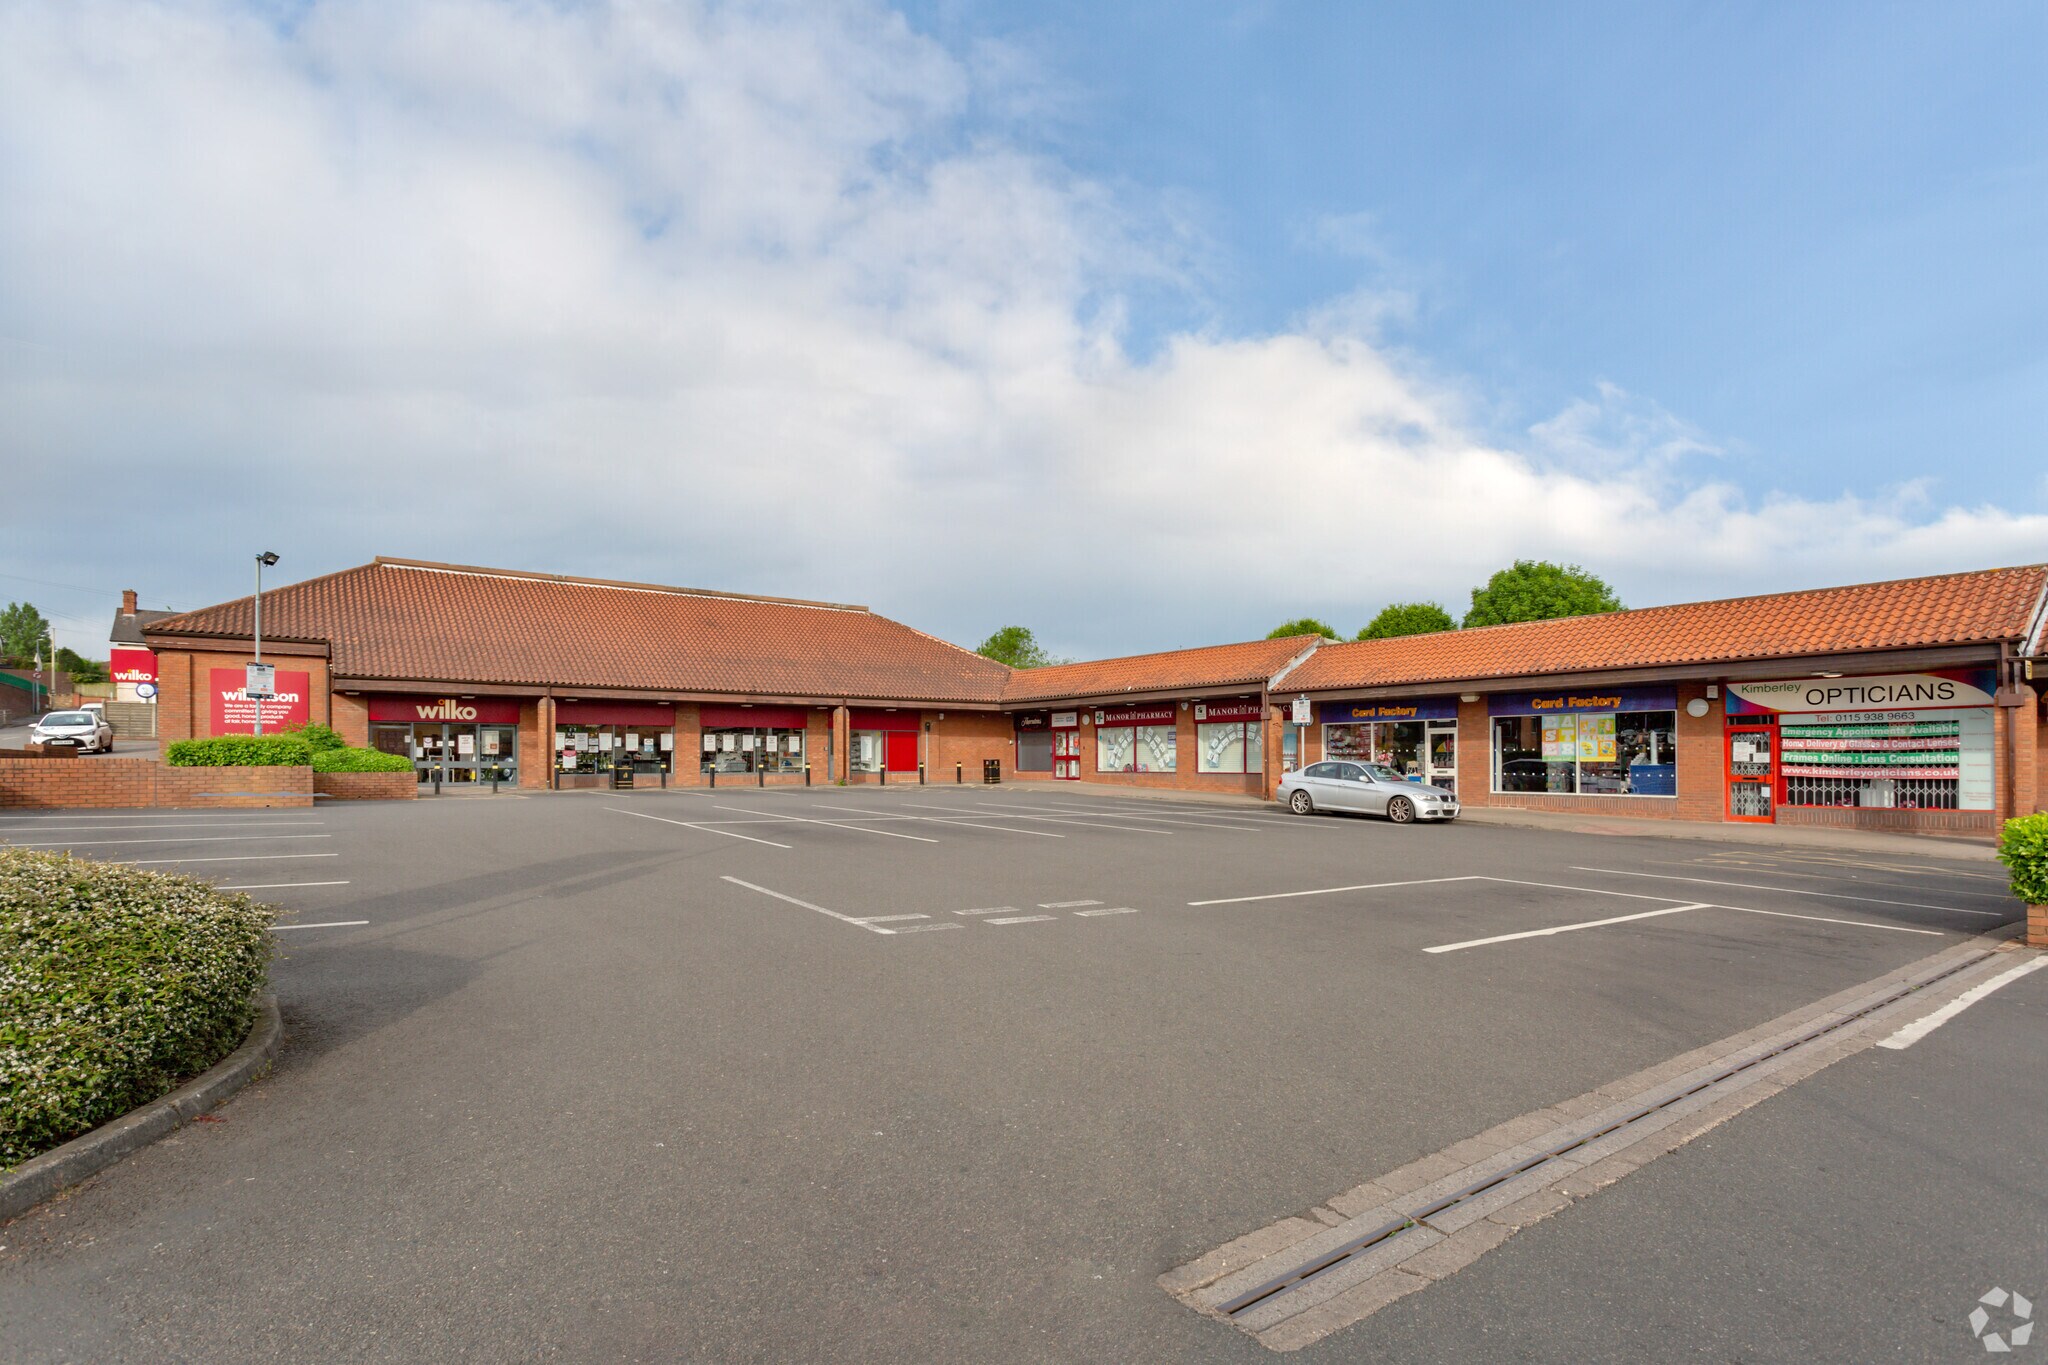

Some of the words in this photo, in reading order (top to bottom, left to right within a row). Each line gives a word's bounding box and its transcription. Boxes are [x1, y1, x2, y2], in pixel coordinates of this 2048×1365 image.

[114, 669, 152, 681] wilko
[1741, 683, 1801, 693] Kimberley
[1806, 682, 1955, 705] OPTICIANS
[222, 687, 299, 703] wilson
[1531, 697, 1564, 709] Card
[1568, 696, 1622, 709] Factory
[415, 699, 477, 720] wilko
[1208, 707, 1239, 717] MANOR
[1351, 707, 1375, 718] Card
[1378, 706, 1418, 717] Factory
[1105, 714, 1130, 722] MANOR
[1137, 711, 1173, 720] PHARMACY
[1815, 714, 1832, 723] Tel:
[1835, 713, 1861, 722] 0115
[1864, 712, 1884, 721] 938
[1887, 712, 1915, 721] 9663
[1781, 726, 1833, 737] Emergency
[1836, 727, 1906, 738] Appointments
[1909, 724, 1959, 735] Available
[1782, 739, 1805, 747] Home
[1806, 740, 1838, 749] Delivery
[1848, 740, 1881, 748] Glasses
[1882, 740, 1889, 748] &
[1891, 740, 1925, 748] Contact
[1927, 738, 1958, 747] Lenses
[1783, 752, 1819, 762] Frames
[1821, 754, 1852, 763] Online
[1861, 755, 1886, 763] Lens
[1889, 753, 1959, 763] Consultation
[1782, 766, 1959, 778] www.kimberleyopticians.co.uk
